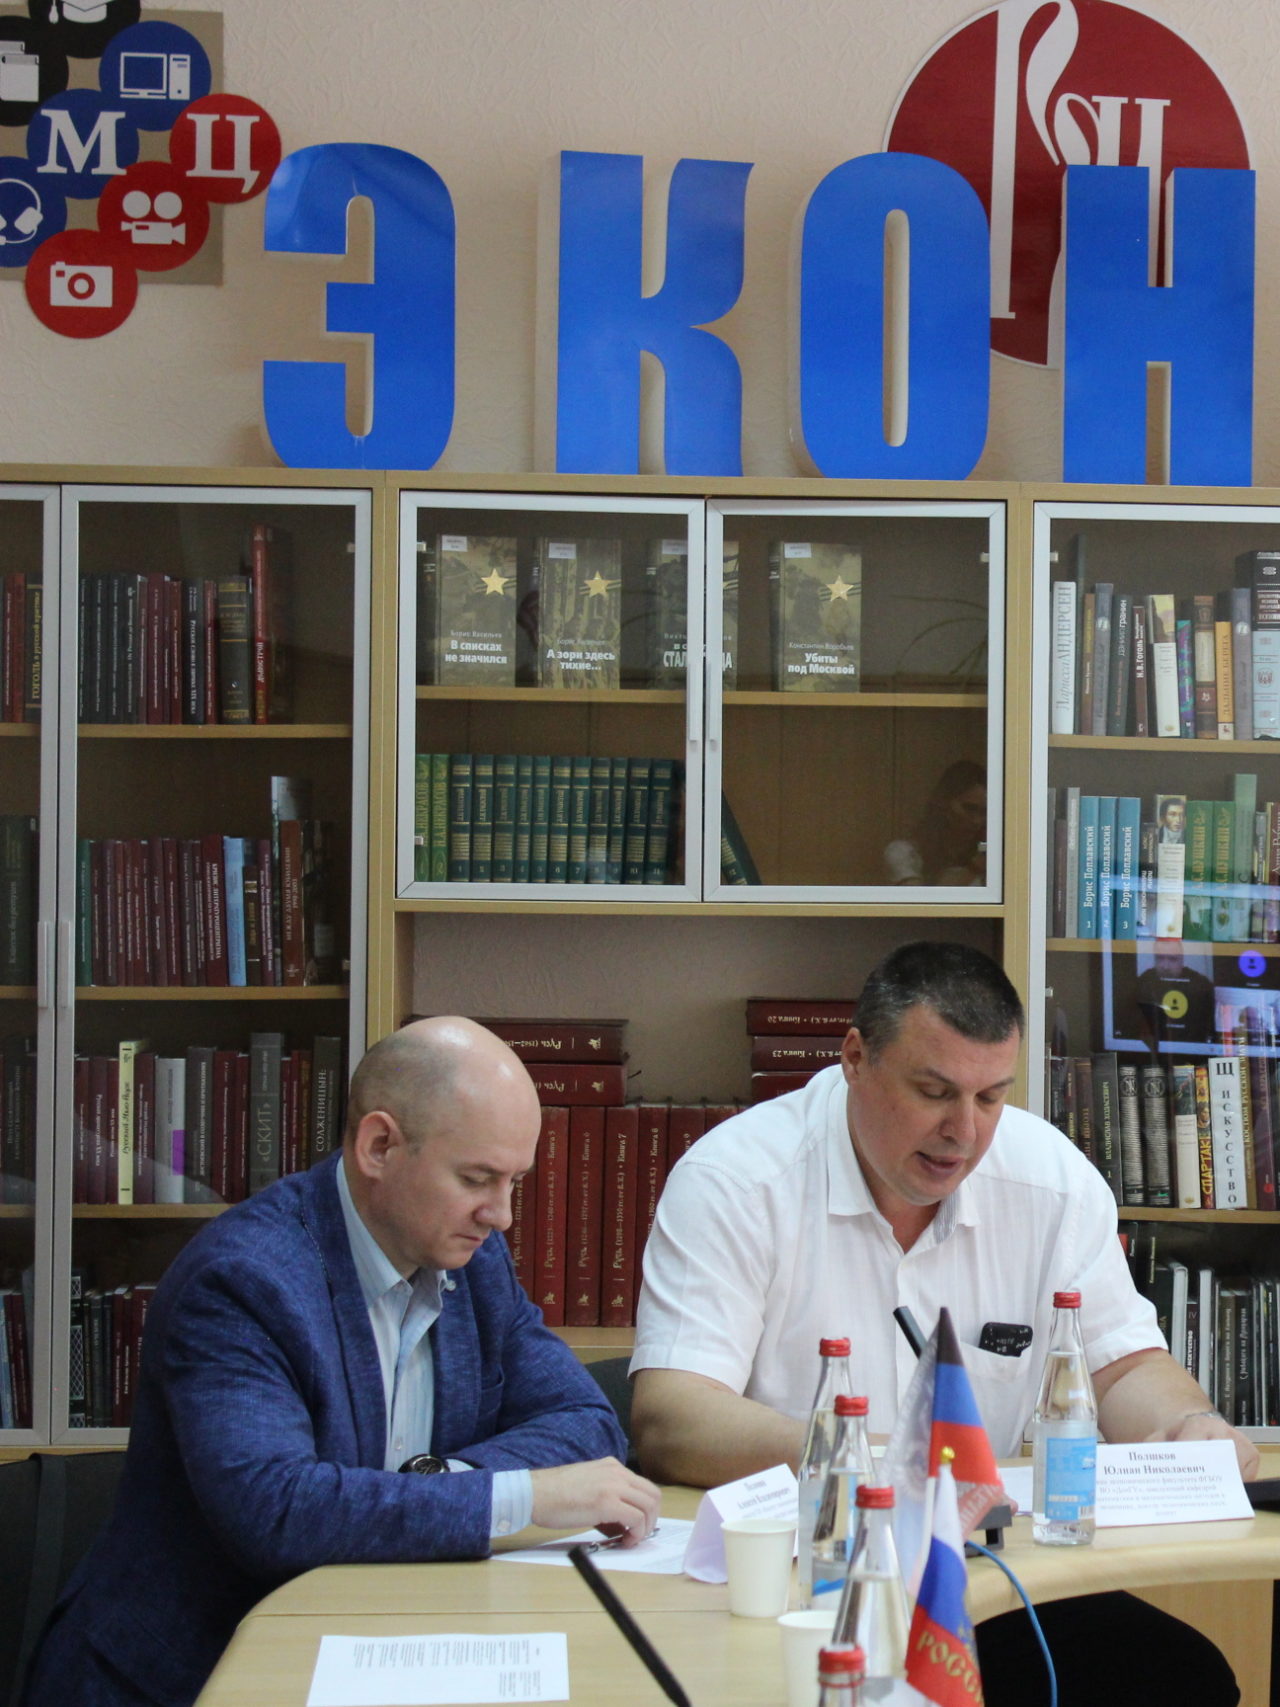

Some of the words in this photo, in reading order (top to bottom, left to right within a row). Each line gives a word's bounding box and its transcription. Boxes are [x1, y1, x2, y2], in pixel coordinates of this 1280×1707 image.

[37, 108, 126, 176] М
[186, 112, 261, 194] Ц
[1055, 587, 1073, 661] АНДЕРСЕН
[32, 624, 42, 655] русской
[451, 640, 458, 650] В
[460, 641, 502, 652] списках
[445, 654, 457, 663] не
[459, 654, 508, 664] значился
[546, 649, 556, 659] А
[558, 650, 583, 661] зори
[584, 651, 616, 662] здесь
[804, 653, 839, 664] Убиты
[788, 665, 807, 675] под
[809, 662, 855, 675] Москвой
[31, 662, 41, 699] ГОГОЛЬ
[1084, 826, 1094, 879] Поплавский
[1100, 825, 1111, 878] Поплавский
[1121, 826, 1132, 880] Поплавский
[1083, 881, 1094, 908] Борис
[1101, 881, 1112, 907] Борис
[1120, 882, 1131, 908] Борис
[767, 1015, 777, 1023] 20
[779, 1015, 800, 1023] Книга
[541, 1038, 562, 1050] Русь
[772, 1050, 782, 1058] 23
[783, 1050, 805, 1058] Книга
[1216, 1062, 1233, 1076] Щ
[545, 1080, 565, 1092] Русь
[1240, 1066, 1249, 1103] РУССКОЙ
[1102, 1082, 1111, 1119] ХОДАСЕВИЧ
[257, 1103, 272, 1162] «СКИТ»
[1241, 1107, 1250, 1143] КОСТЮМ
[121, 1123, 131, 1155] Русский
[548, 1137, 556, 1159] Книга
[582, 1139, 590, 1160] Книга
[650, 1135, 658, 1156] Книга
[1104, 1121, 1113, 1160] ВЛАДИСЛАВ
[1222, 1090, 1237, 1204] ИСКУССТВО
[618, 1140, 626, 1162] Книга
[1199, 1138, 1213, 1195] СПАРТАК
[544, 1247, 556, 1268] Русь
[578, 1247, 590, 1267] Русь
[613, 1248, 625, 1269] Русь
[1103, 1465, 1140, 1476] Юлиан
[1143, 1464, 1206, 1475] Николаевич
